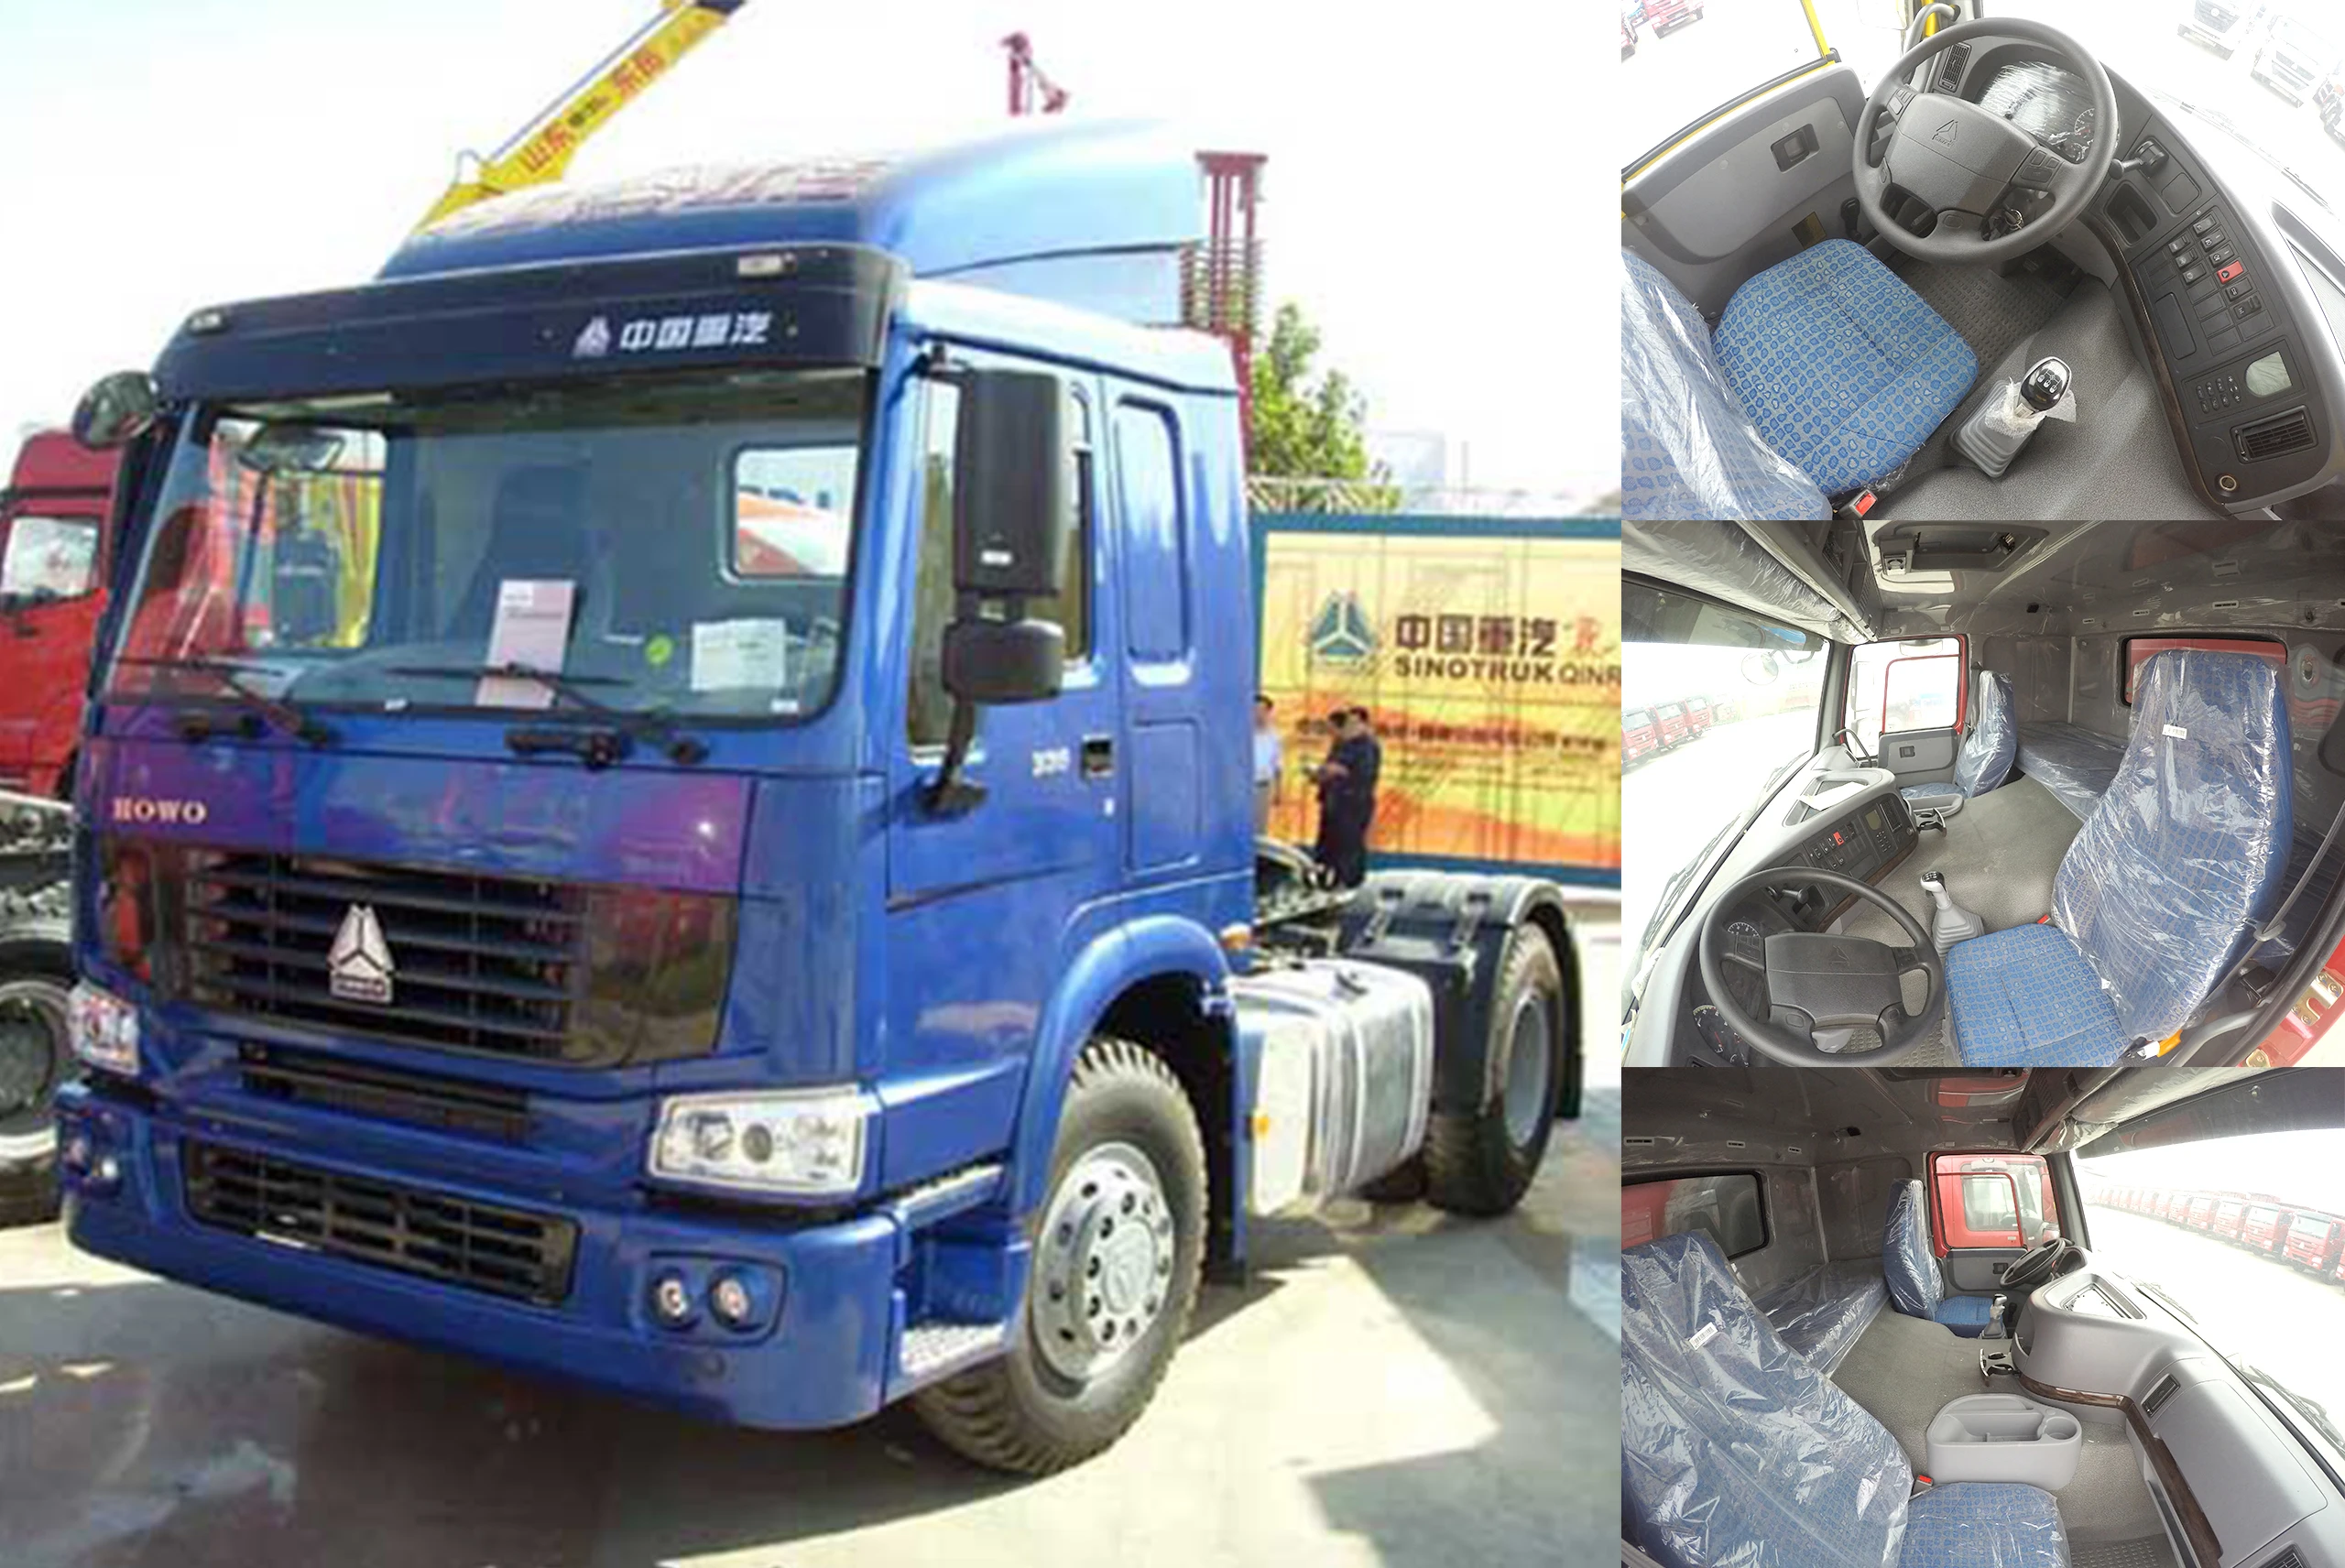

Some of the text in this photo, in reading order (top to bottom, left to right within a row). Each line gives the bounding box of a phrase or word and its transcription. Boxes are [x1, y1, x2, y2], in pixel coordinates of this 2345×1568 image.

[619, 312, 772, 351] 中国重汽
[1396, 614, 1556, 658] 中国重汽
[1394, 655, 1554, 684] SINOTRUK
[113, 796, 208, 824] HOWO
